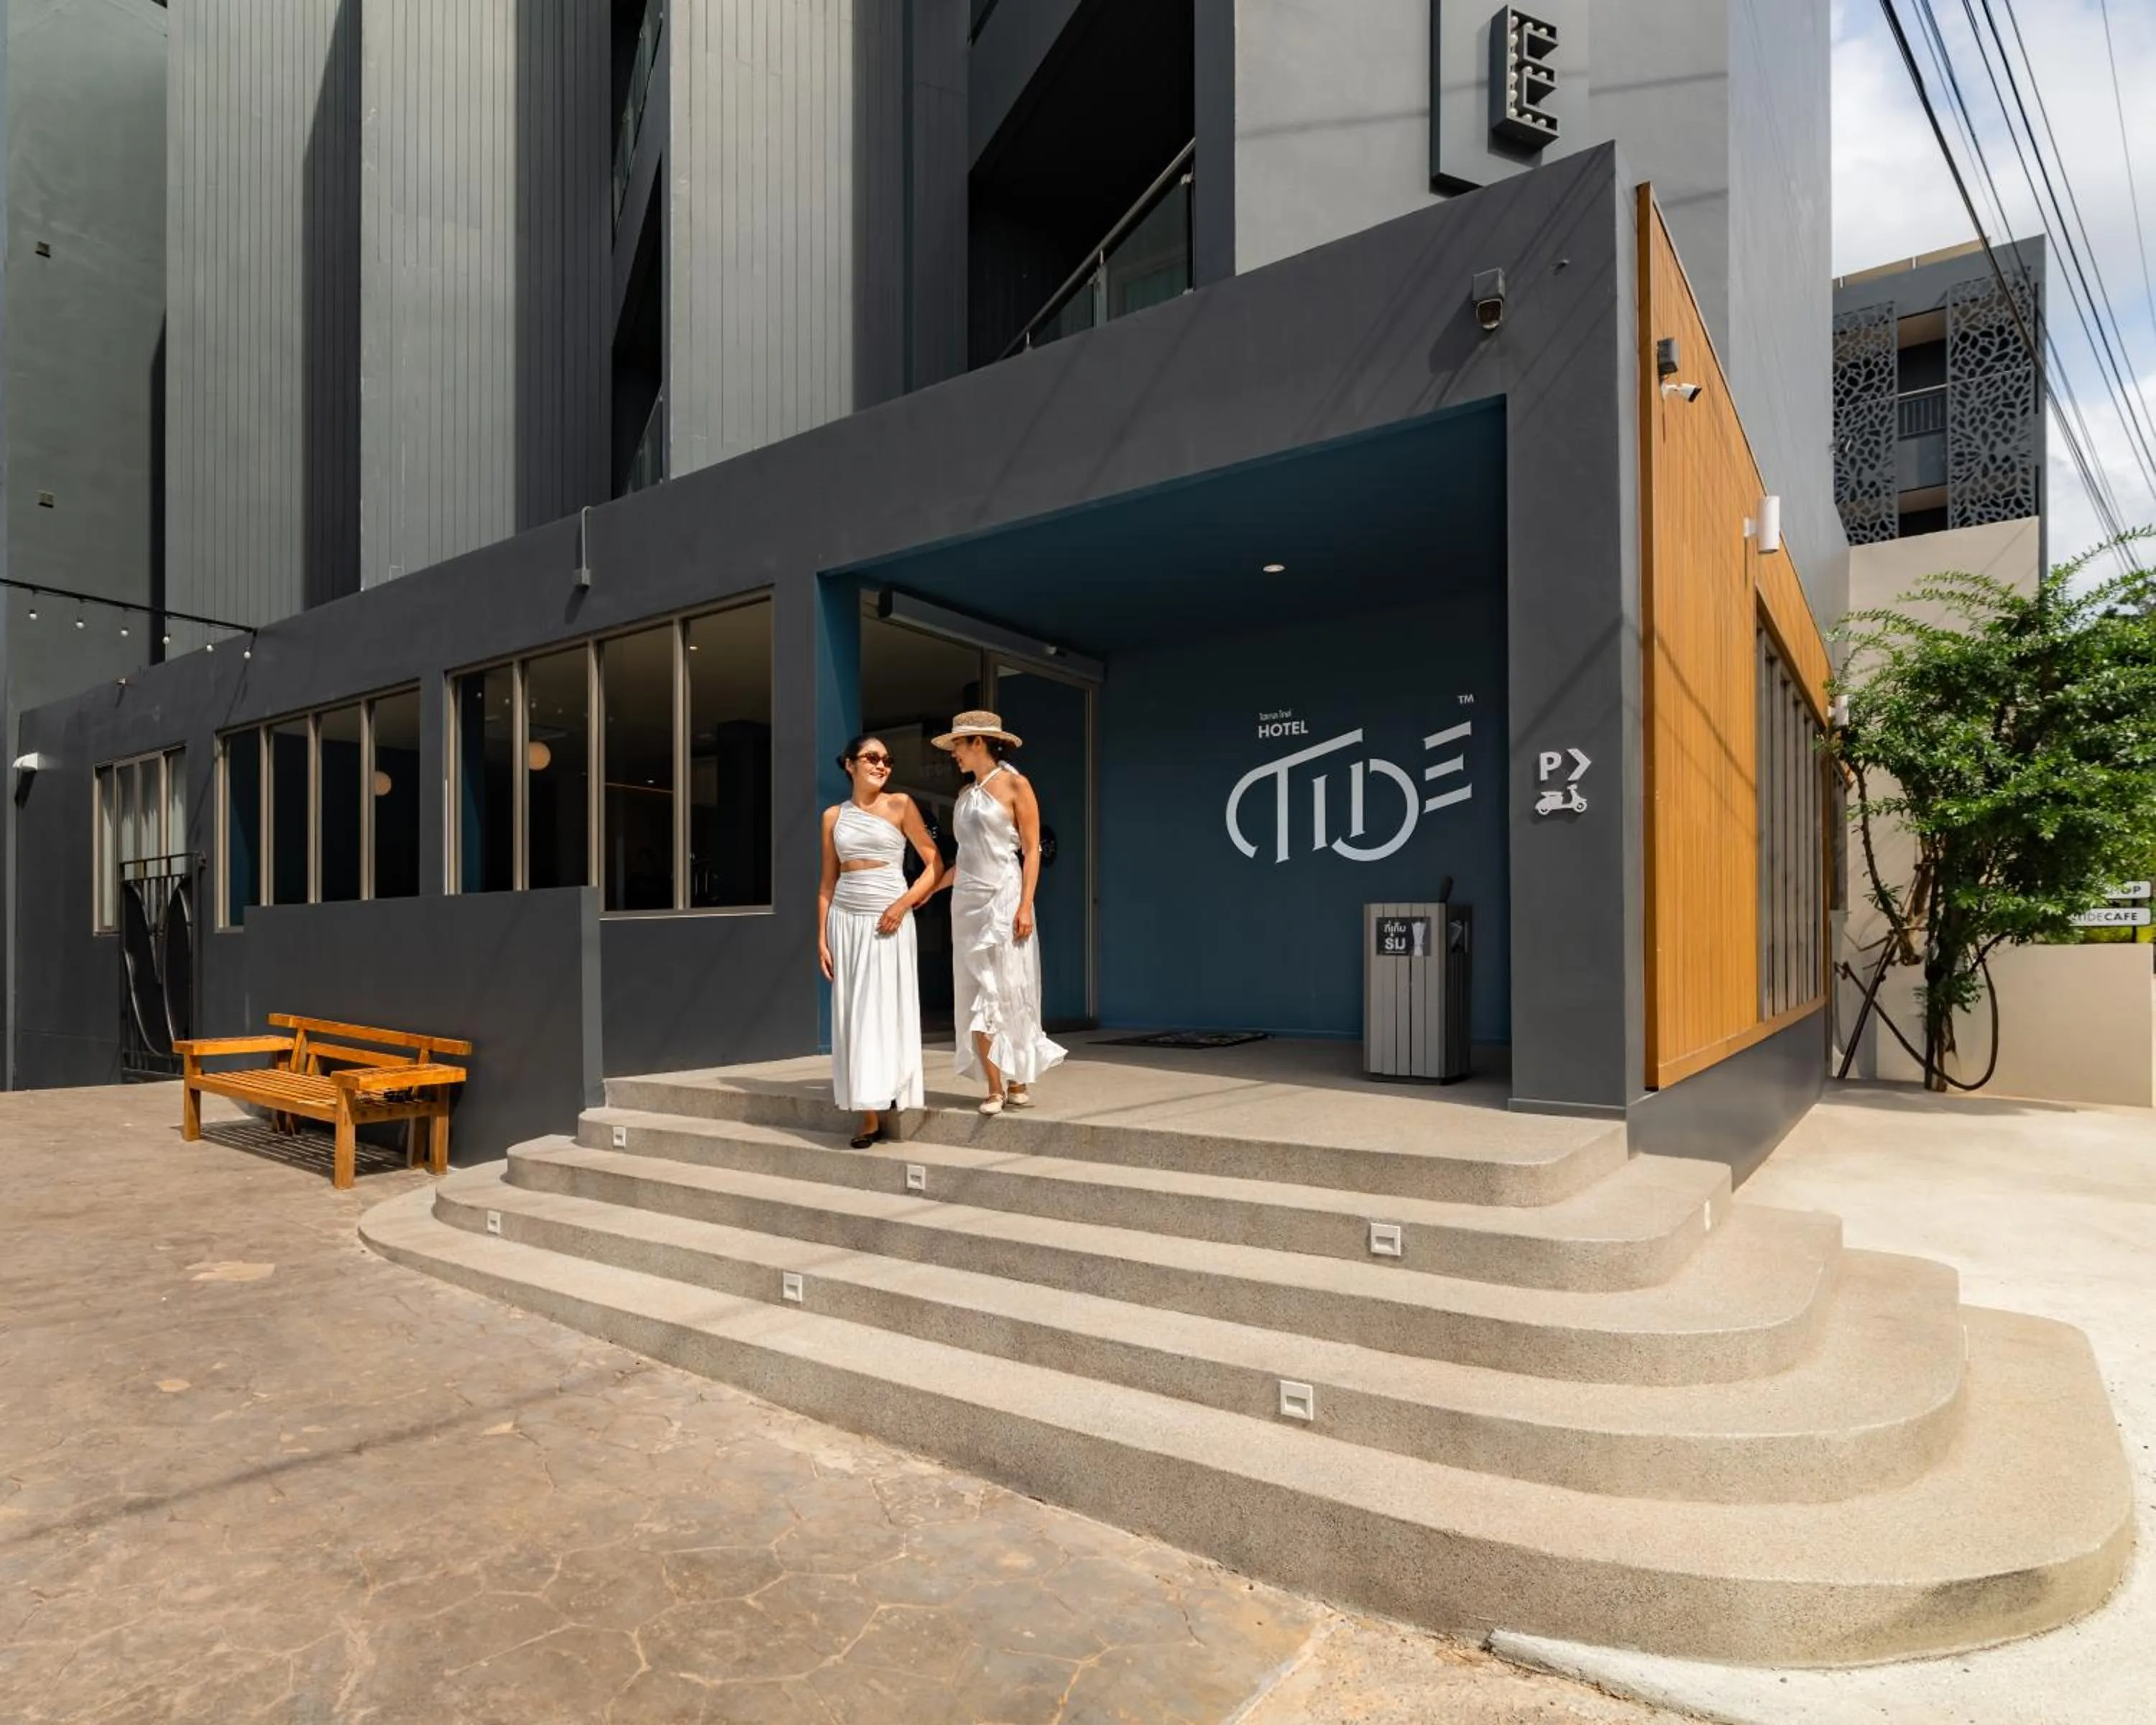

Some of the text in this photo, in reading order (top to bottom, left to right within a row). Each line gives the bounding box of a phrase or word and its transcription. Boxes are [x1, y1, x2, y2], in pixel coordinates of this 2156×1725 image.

[1258, 720, 1309, 739] HOTEL
[1539, 752, 1562, 781] P
[1225, 720, 1473, 862] TIDE
